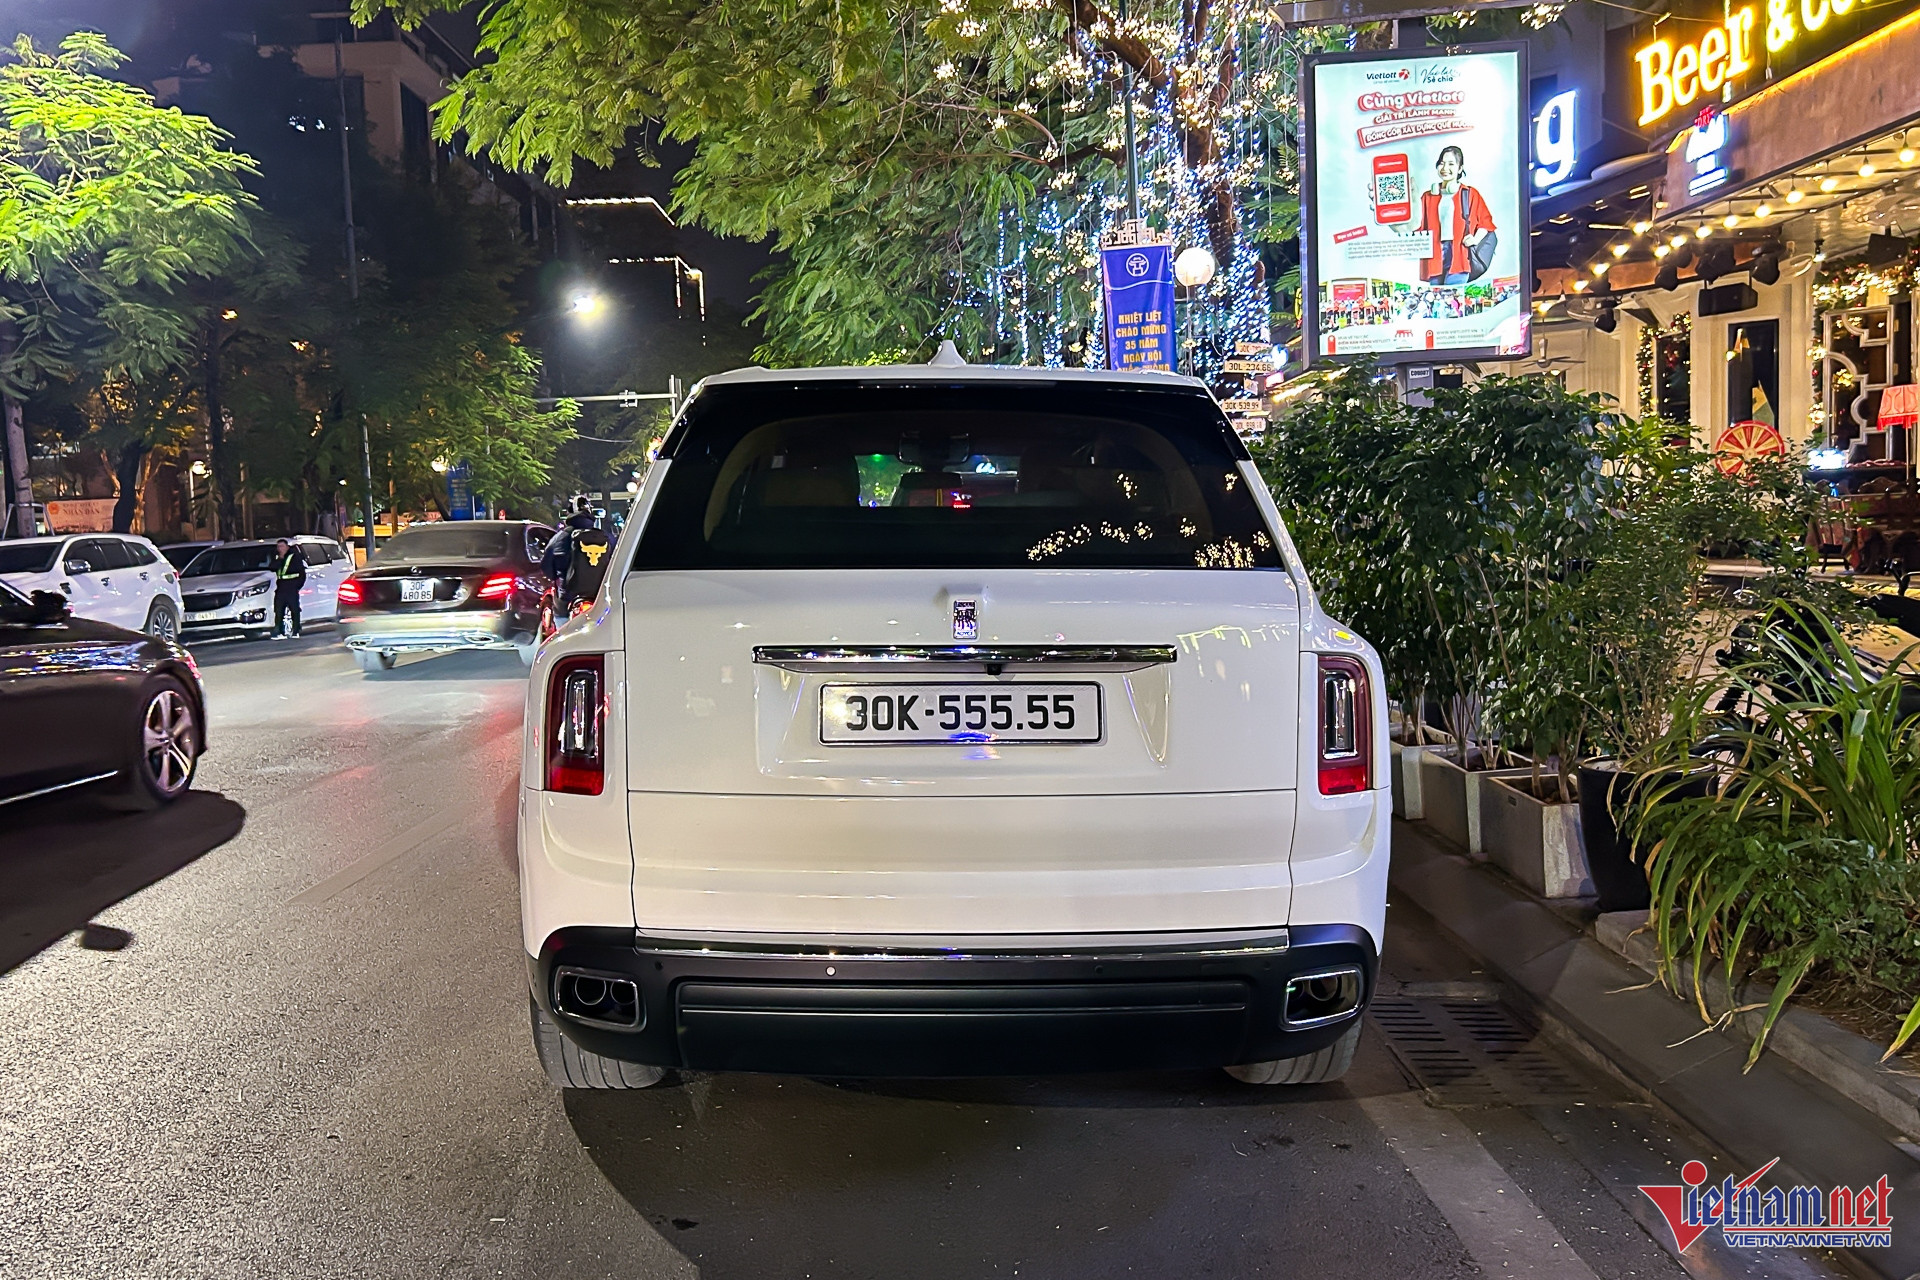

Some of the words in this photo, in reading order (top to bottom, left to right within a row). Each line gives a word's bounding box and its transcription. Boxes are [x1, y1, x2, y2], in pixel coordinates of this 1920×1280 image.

[1634, 5, 1756, 127] Beer
[1366, 71, 1397, 80] Vietlott
[1360, 91, 1405, 110] Cùng
[1406, 91, 1465, 104] Vietlott
[1118, 311, 1143, 325] NHIỆT
[1145, 310, 1162, 324] LIỆT
[1115, 326, 1139, 338] CHÀO
[1141, 324, 1167, 336] MỪNG
[1125, 340, 1136, 351] 35
[1139, 337, 1158, 349] NĂM
[1123, 352, 1146, 364] NGÀY
[1147, 350, 1162, 363] HỘI
[410, 581, 425, 591] 30F
[846, 694, 1075, 731] 30K-555.55
